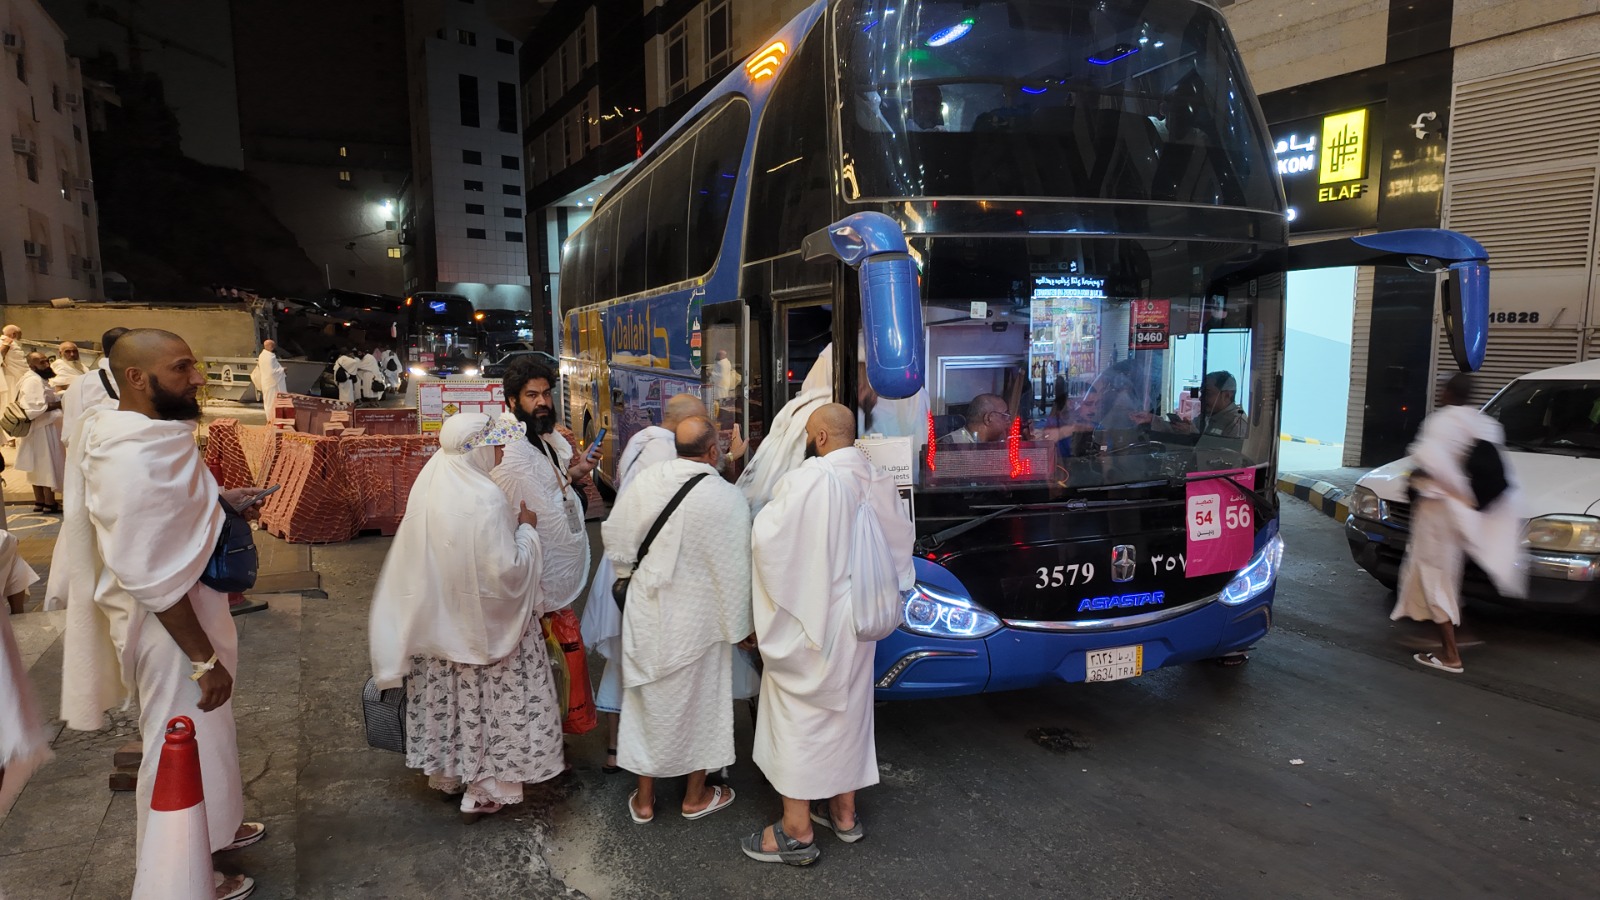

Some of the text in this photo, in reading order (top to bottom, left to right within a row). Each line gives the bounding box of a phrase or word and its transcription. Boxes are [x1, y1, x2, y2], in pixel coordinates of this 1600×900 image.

[1318, 183, 1361, 202] ELAF
[1488, 311, 1540, 323] 18828
[616, 312, 645, 350] Dallah
[1137, 332, 1163, 343] 9460
[1195, 510, 1213, 526] 54
[1225, 503, 1251, 530] 56
[1151, 552, 1188, 576] ٣٥٧
[1035, 562, 1095, 589] 3579
[1077, 590, 1166, 612] ASIASTAR
[1090, 666, 1134, 682] 3634 TRA
